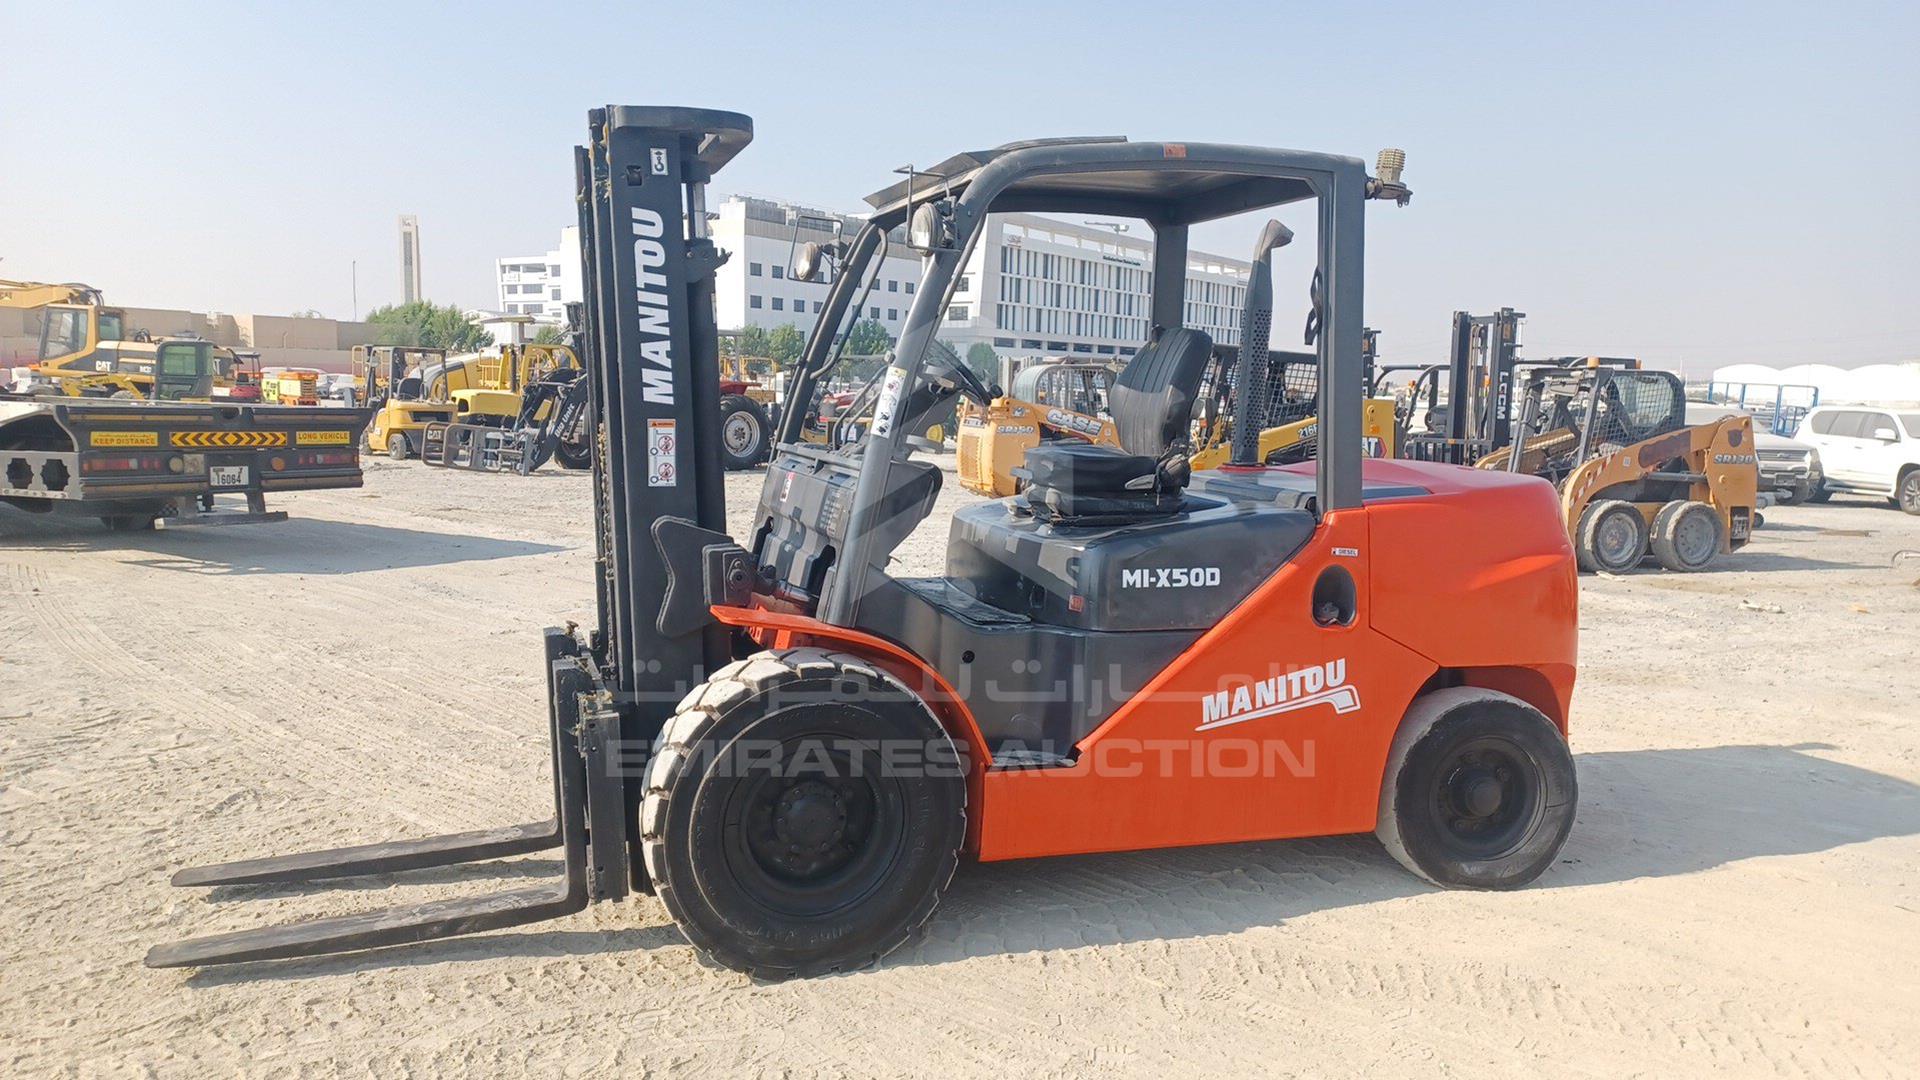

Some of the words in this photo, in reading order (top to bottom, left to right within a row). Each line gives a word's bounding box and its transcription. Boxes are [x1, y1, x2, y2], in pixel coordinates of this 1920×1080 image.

[631, 207, 675, 405] MANITOU
[95, 360, 111, 372] CAT
[1047, 409, 1102, 436] CASE
[427, 430, 441, 440] CAT
[1122, 568, 1221, 588] MI-X50D
[1202, 658, 1346, 723] MANITOU
